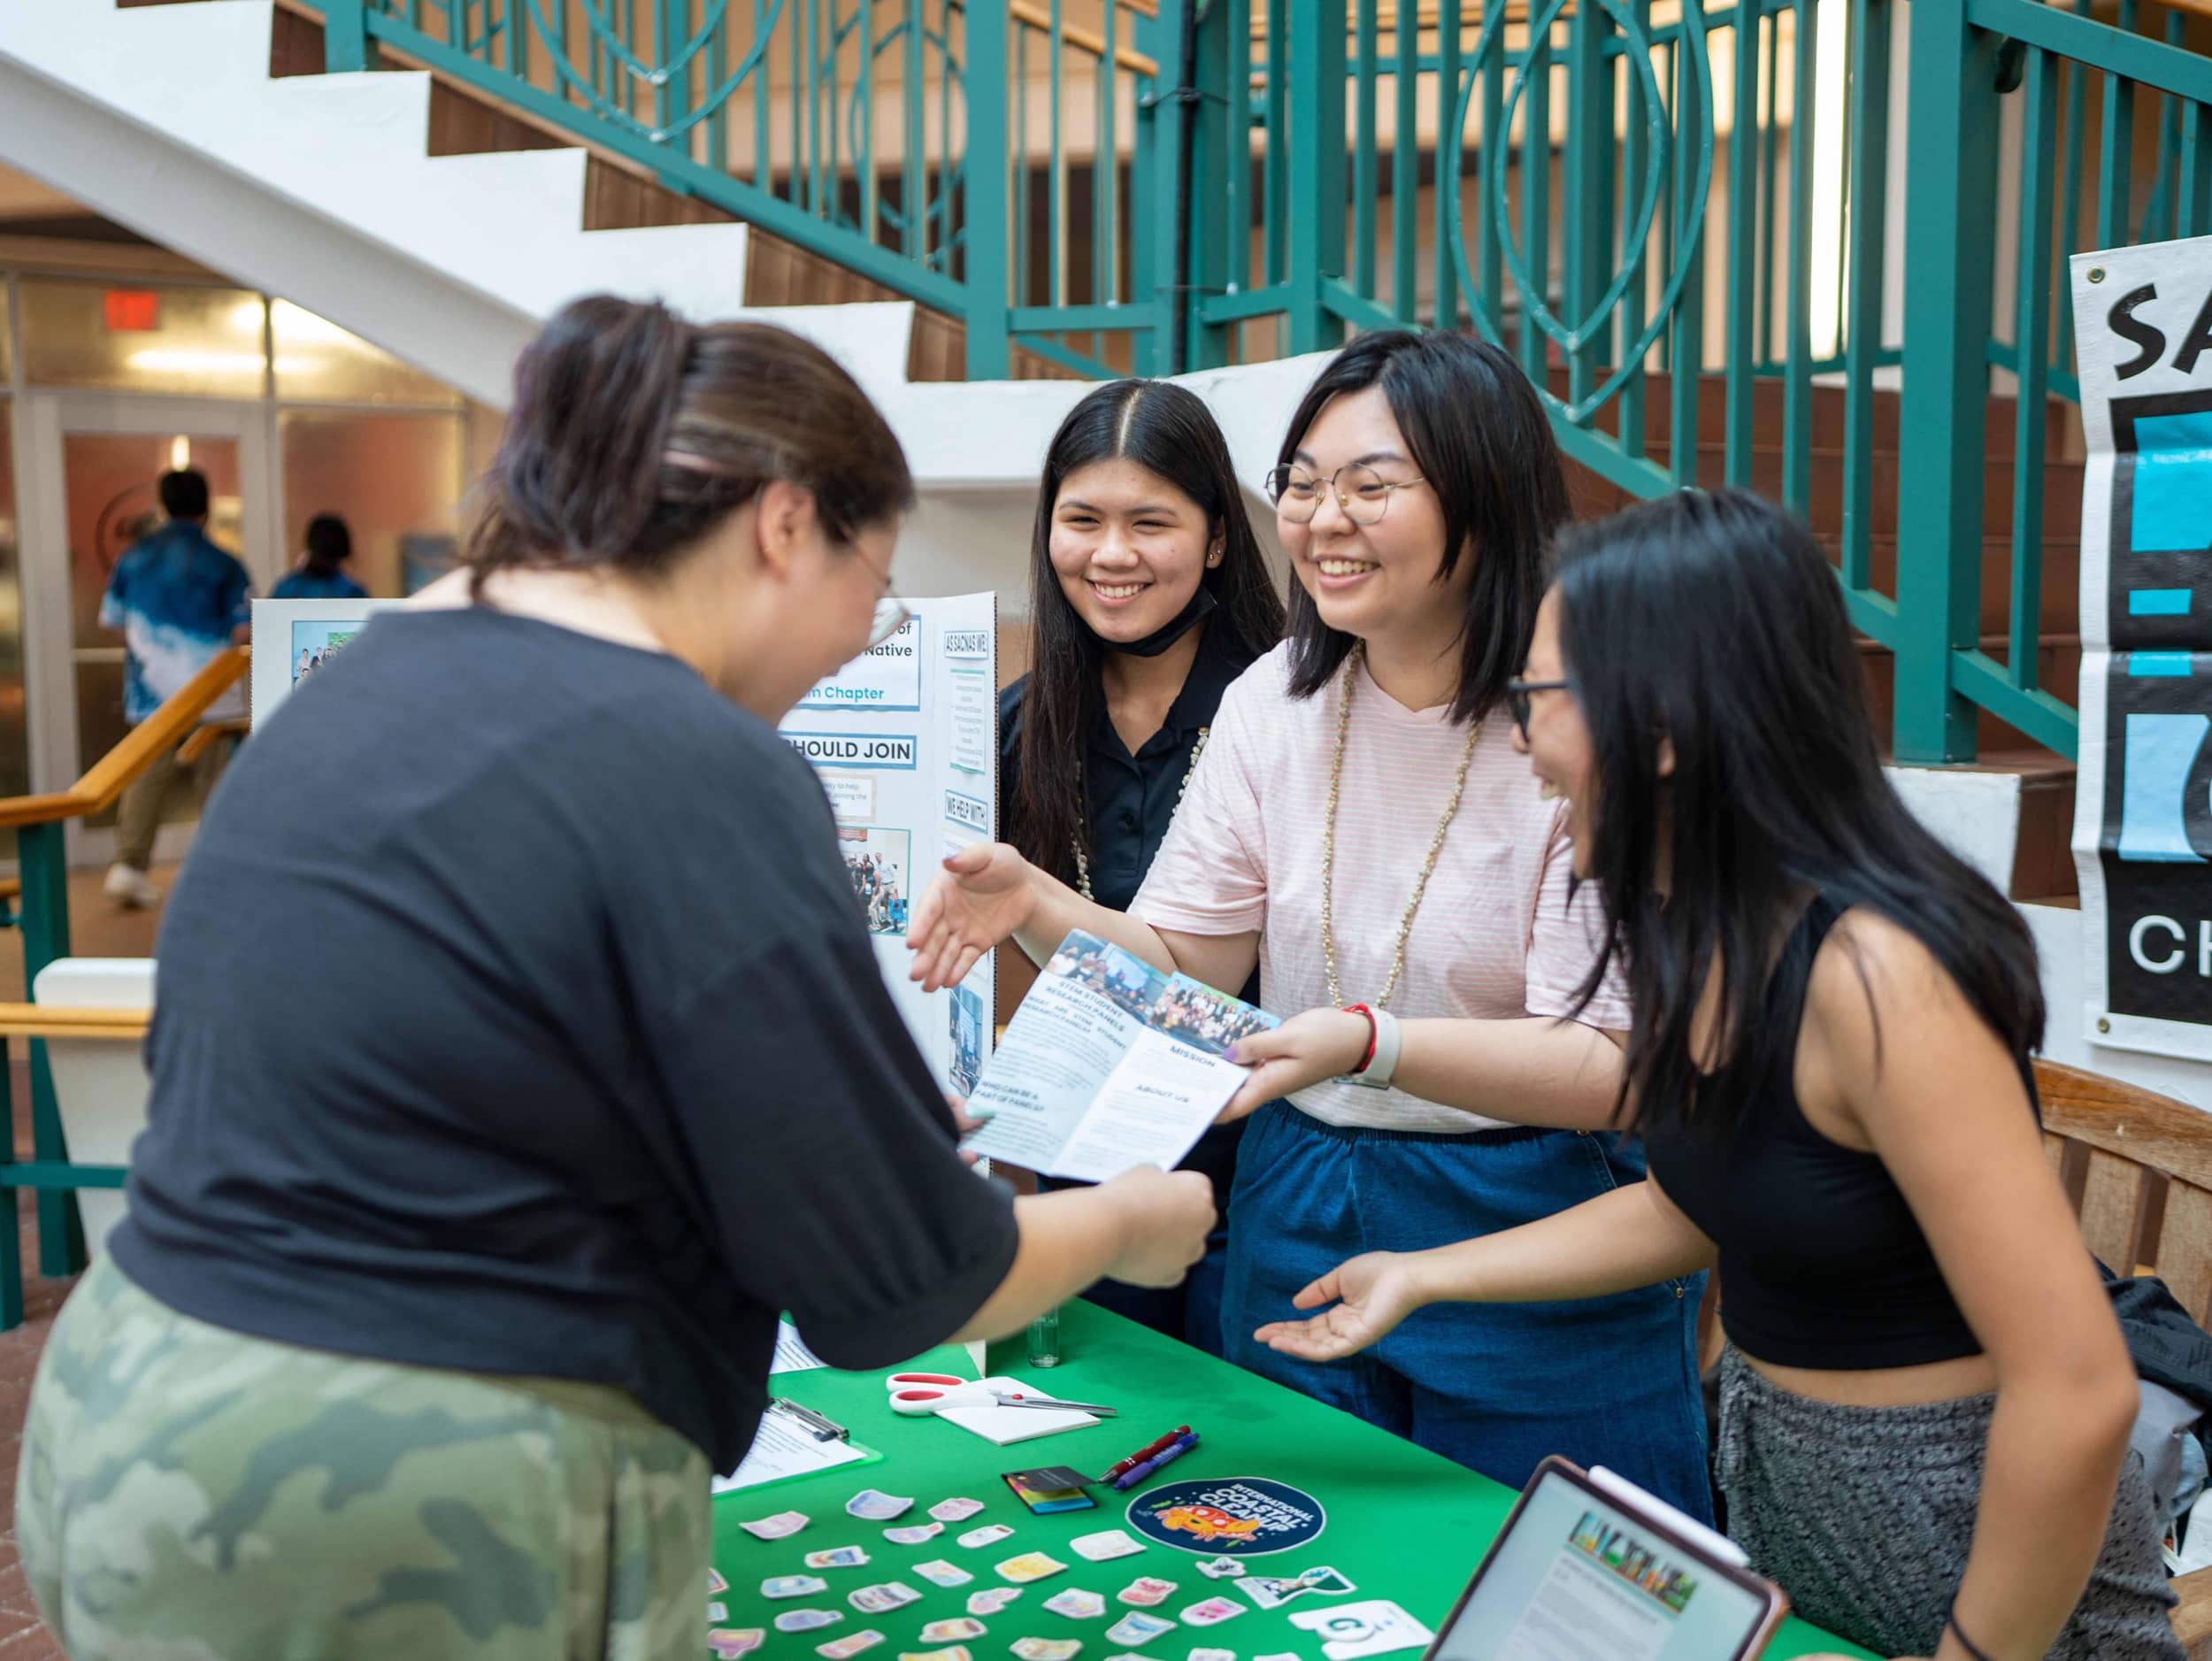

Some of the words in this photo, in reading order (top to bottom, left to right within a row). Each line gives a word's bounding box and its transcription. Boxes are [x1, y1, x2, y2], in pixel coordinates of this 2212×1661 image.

[897, 622, 912, 634] of
[864, 643, 912, 657] Native
[825, 687, 885, 703] Chapter
[784, 740, 858, 757] HOULD
[864, 742, 910, 759] JOIN
[1046, 985, 1092, 1010] RESEARCH
[1059, 981, 1083, 995] STEM
[1084, 992, 1124, 1018] STUDENT
[1169, 1045, 1217, 1068] MISSION
[1135, 1084, 1174, 1097] ABOUT
[1199, 1493, 1290, 1532] CLEANUP
[1216, 1488, 1302, 1529] COASTAL
[1231, 1483, 1315, 1522] INTERNATIONAL
